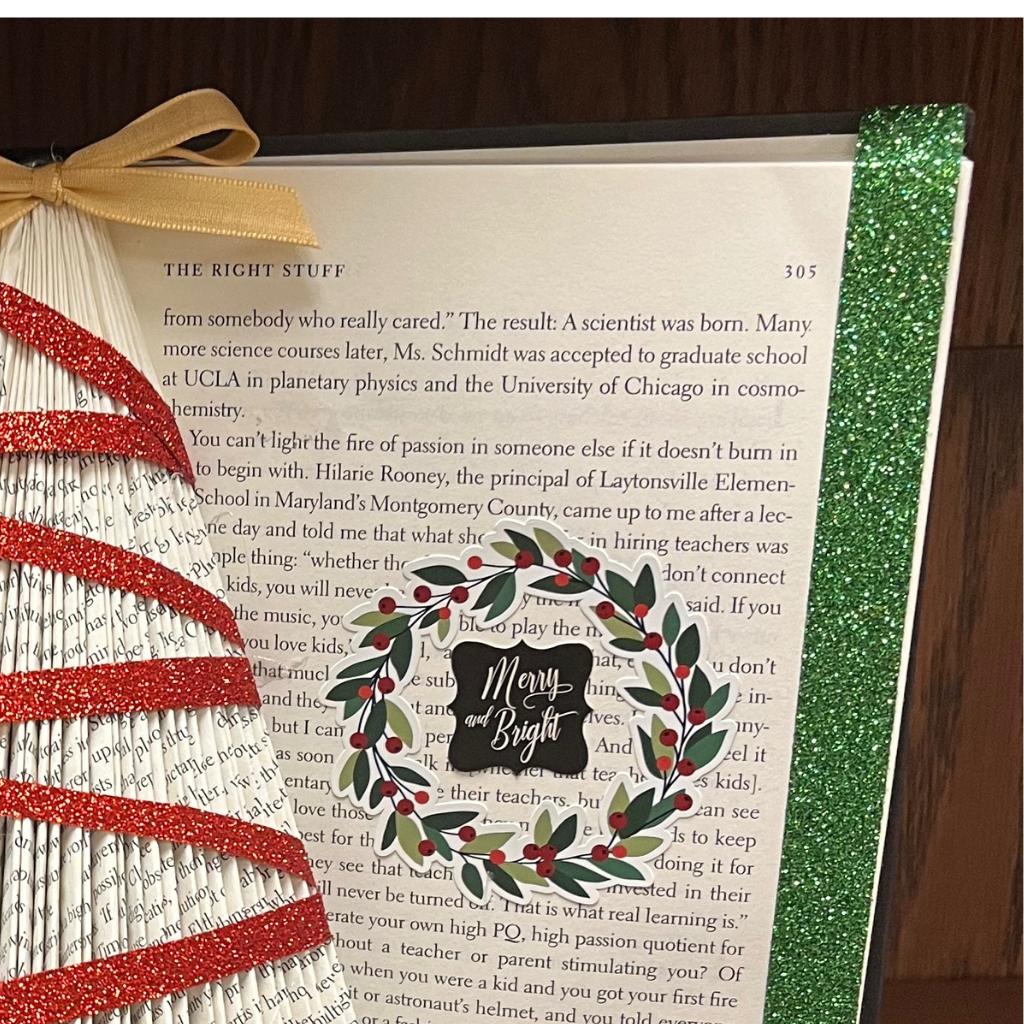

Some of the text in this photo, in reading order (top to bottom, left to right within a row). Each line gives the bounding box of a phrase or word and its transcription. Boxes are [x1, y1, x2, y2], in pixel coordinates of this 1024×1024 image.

[164, 263, 345, 278] THE RIGHT STUFF
[786, 265, 817, 279] 305
[164, 307, 812, 338] from somebody who really cared.” The result: A scientist was born. Many
[162, 369, 805, 402] at UCLA in planetary physics and the University of Chicago in cosmo-
[590, 531, 789, 557] in hiring teachers was
[481, 656, 573, 709] Merry
[464, 705, 579, 764] and Bright
[715, 772, 761, 795] kids].
[715, 829, 756, 853] keep
[654, 853, 754, 878] doing it for
[368, 916, 745, 956] your own high PQ, high passion quotient for
[385, 993, 469, 1013] astronaut’s
[476, 999, 538, 1022] helmet,
[545, 1007, 576, 1023] and
